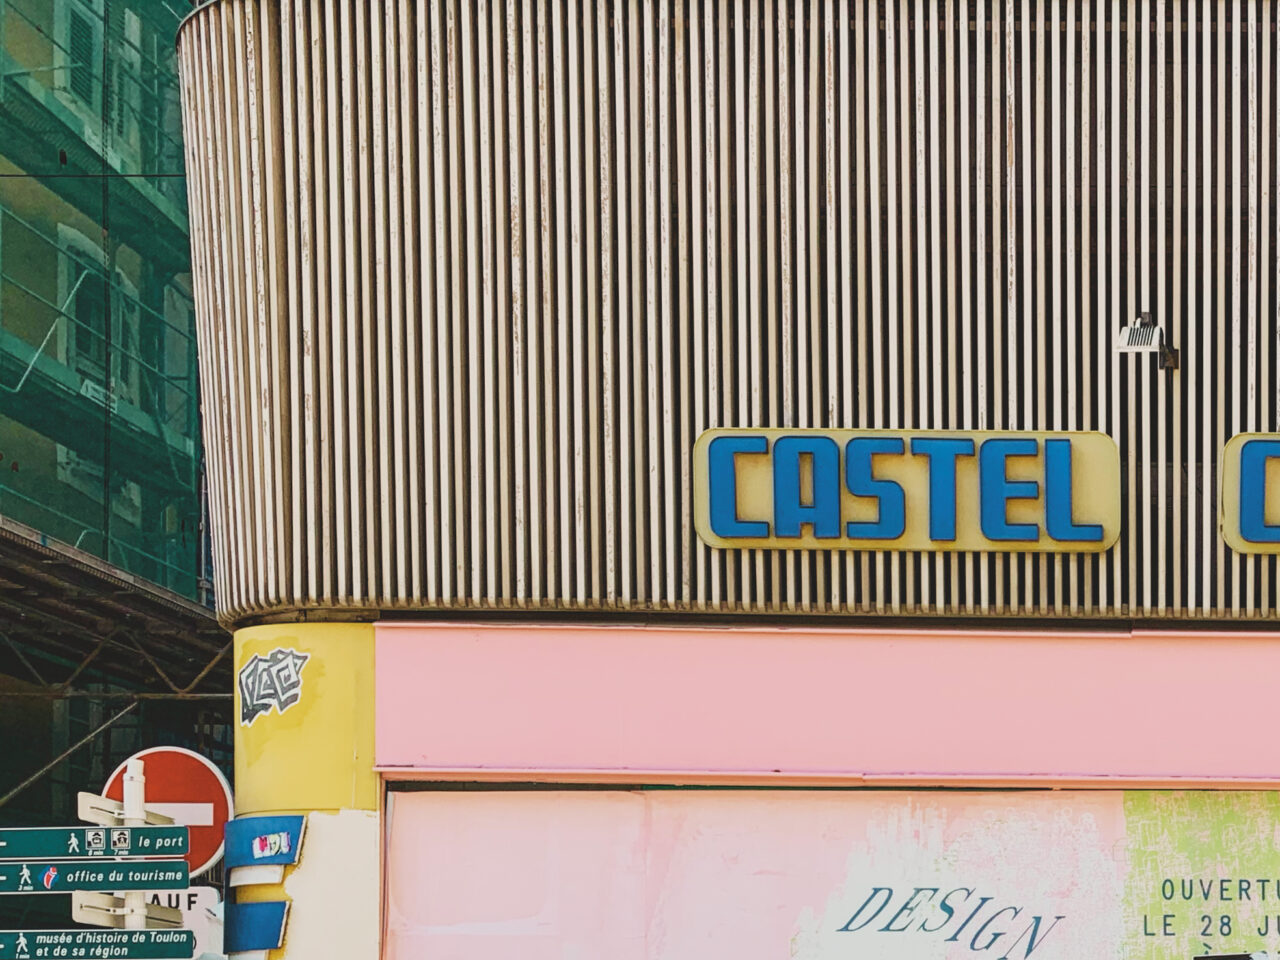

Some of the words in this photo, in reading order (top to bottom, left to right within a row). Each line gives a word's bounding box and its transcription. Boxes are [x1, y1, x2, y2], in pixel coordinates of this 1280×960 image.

[708, 435, 1104, 542] CASTEL
[138, 835, 150, 847] le
[156, 836, 183, 849] port
[67, 870, 104, 882] office
[109, 870, 123, 881] du
[128, 870, 183, 882] tourisme
[835, 887, 1066, 960] DESIGN
[1143, 914, 1176, 936] LE
[1200, 914, 1232, 937] 28
[36, 932, 72, 944] musée
[76, 932, 128, 944] d'histoire
[132, 931, 146, 943] de
[150, 931, 187, 943] Toulon
[36, 946, 49, 957] et
[53, 945, 67, 956] de
[72, 947, 86, 957] sa
[90, 945, 129, 958] région
